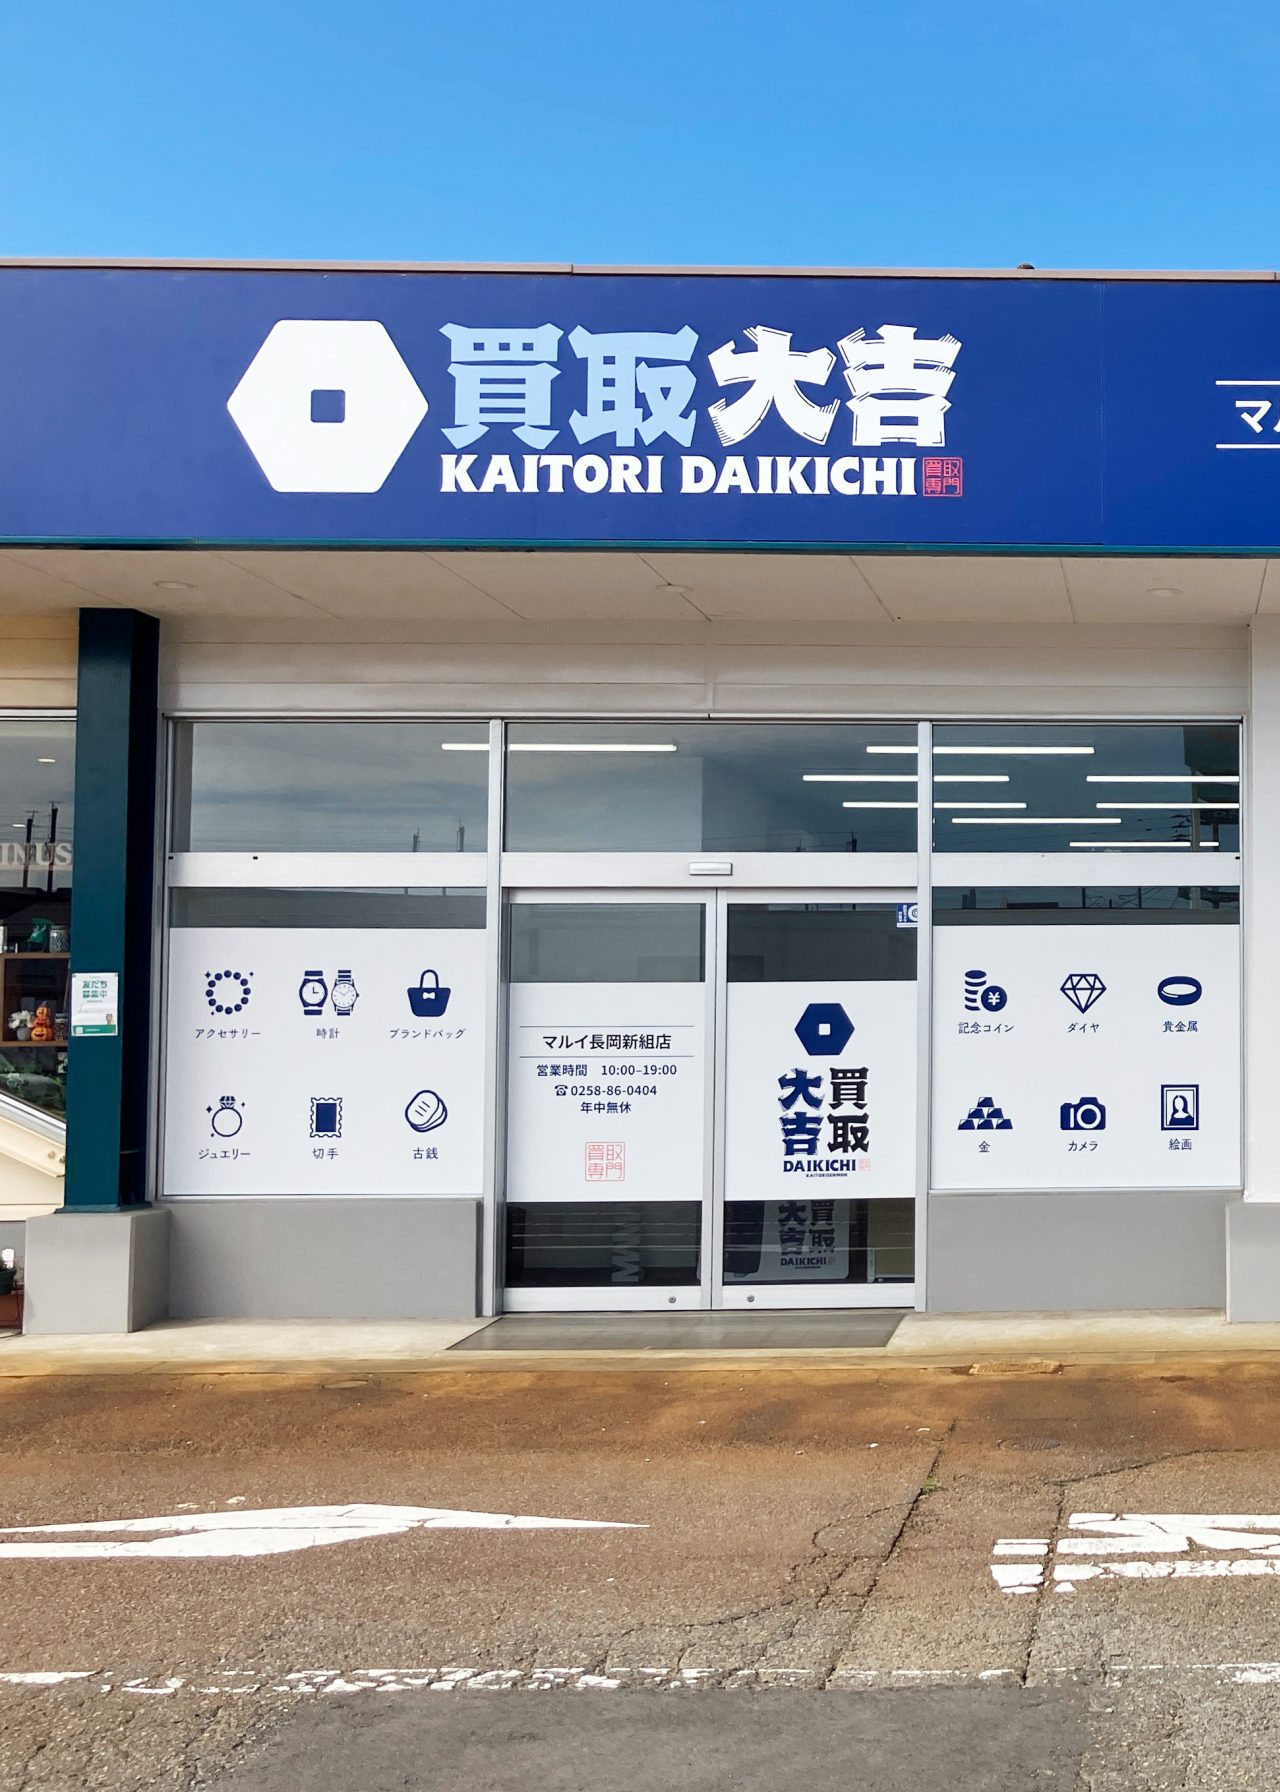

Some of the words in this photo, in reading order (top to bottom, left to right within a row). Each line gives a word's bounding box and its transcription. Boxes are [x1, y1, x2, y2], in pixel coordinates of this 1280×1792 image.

[439, 322, 962, 450] 買取大吉
[440, 454, 663, 493] KAITORI
[680, 455, 917, 496] DAIKICHI
[958, 1022, 1014, 1034] 記念コイン
[1067, 1022, 1100, 1034] ダイヤ
[1162, 1020, 1199, 1033] 貴金属
[194, 1028, 262, 1039] アクセサリー
[316, 1028, 340, 1039] 時計
[389, 1028, 467, 1039] ブランドバッグ
[542, 1034, 672, 1050] マルイ長岡新組店
[537, 1064, 588, 1077] 営業時間
[571, 1085, 658, 1096] 0258-86-0404
[580, 1101, 632, 1114] 年中無休
[978, 1140, 991, 1153] 金
[1068, 1140, 1099, 1152] カメラ
[1168, 1138, 1193, 1151] 絵画
[198, 1148, 251, 1160] ジュエリー
[312, 1148, 339, 1160] 切手
[412, 1147, 439, 1160] 古銭
[588, 1144, 623, 1161] 買取
[783, 1159, 856, 1172] DAIKICHI
[781, 1257, 826, 1266] DAIKICHI
